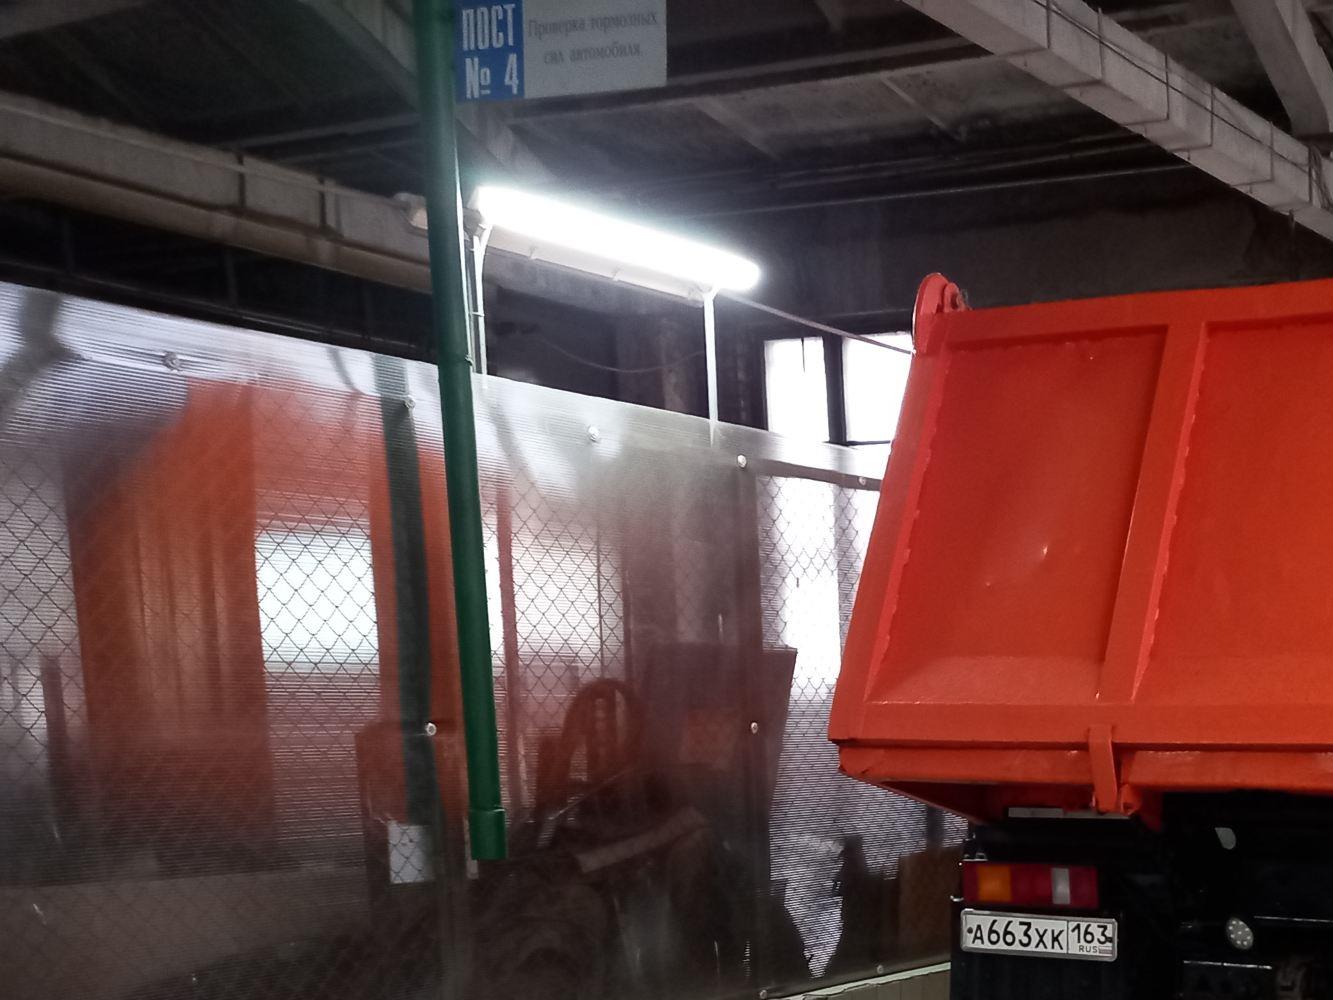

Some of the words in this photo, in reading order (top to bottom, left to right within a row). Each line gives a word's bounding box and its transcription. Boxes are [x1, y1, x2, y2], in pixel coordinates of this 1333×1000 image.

[462, 3, 516, 51] ПОСТ
[528, 17, 586, 40] Проверка
[590, 12, 658, 34] тормозных
[543, 51, 565, 65] сил
[465, 56, 492, 99] №
[504, 53, 519, 95] 4
[1071, 923, 1108, 945] 163
[1078, 944, 1098, 953] RUS
